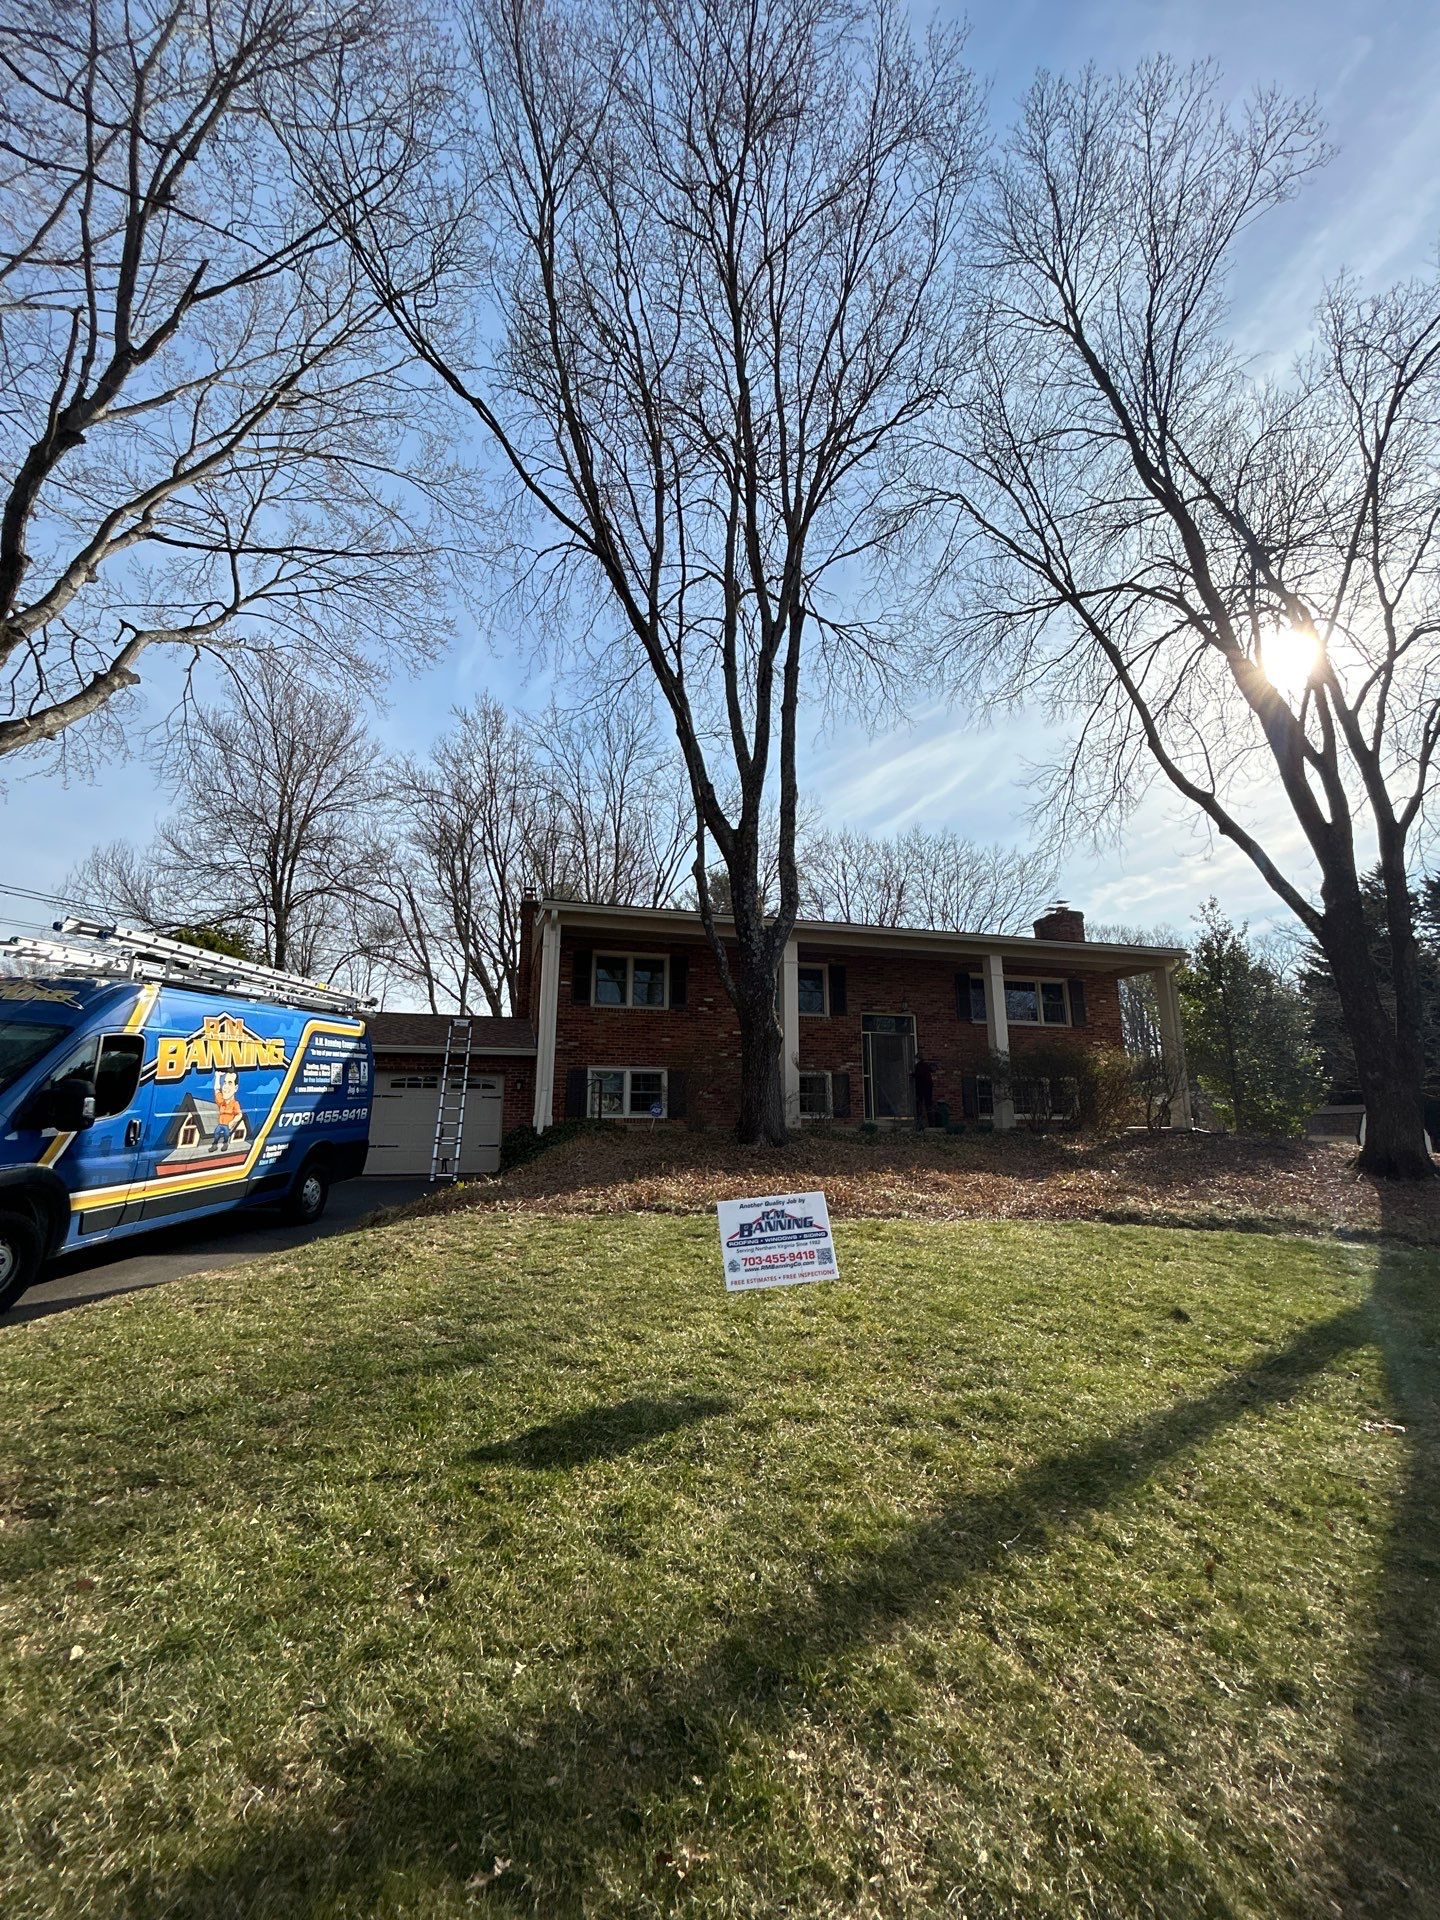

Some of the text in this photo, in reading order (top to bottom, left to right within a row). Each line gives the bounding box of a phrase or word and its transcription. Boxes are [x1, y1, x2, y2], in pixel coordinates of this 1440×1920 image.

[156, 1038, 285, 1080] BANNING
[279, 1111, 314, 1128] (703)
[739, 1202, 763, 1210] Another
[761, 1209, 788, 1220] R.M.
[739, 1216, 814, 1239] BANNING
[728, 1239, 759, 1247] ROOFING
[764, 1235, 798, 1243] WINDOWS
[741, 1250, 816, 1267] 703-455-9418
[746, 1275, 777, 1284] ESTIMATES
[798, 1269, 835, 1278] INSPECTIONS
